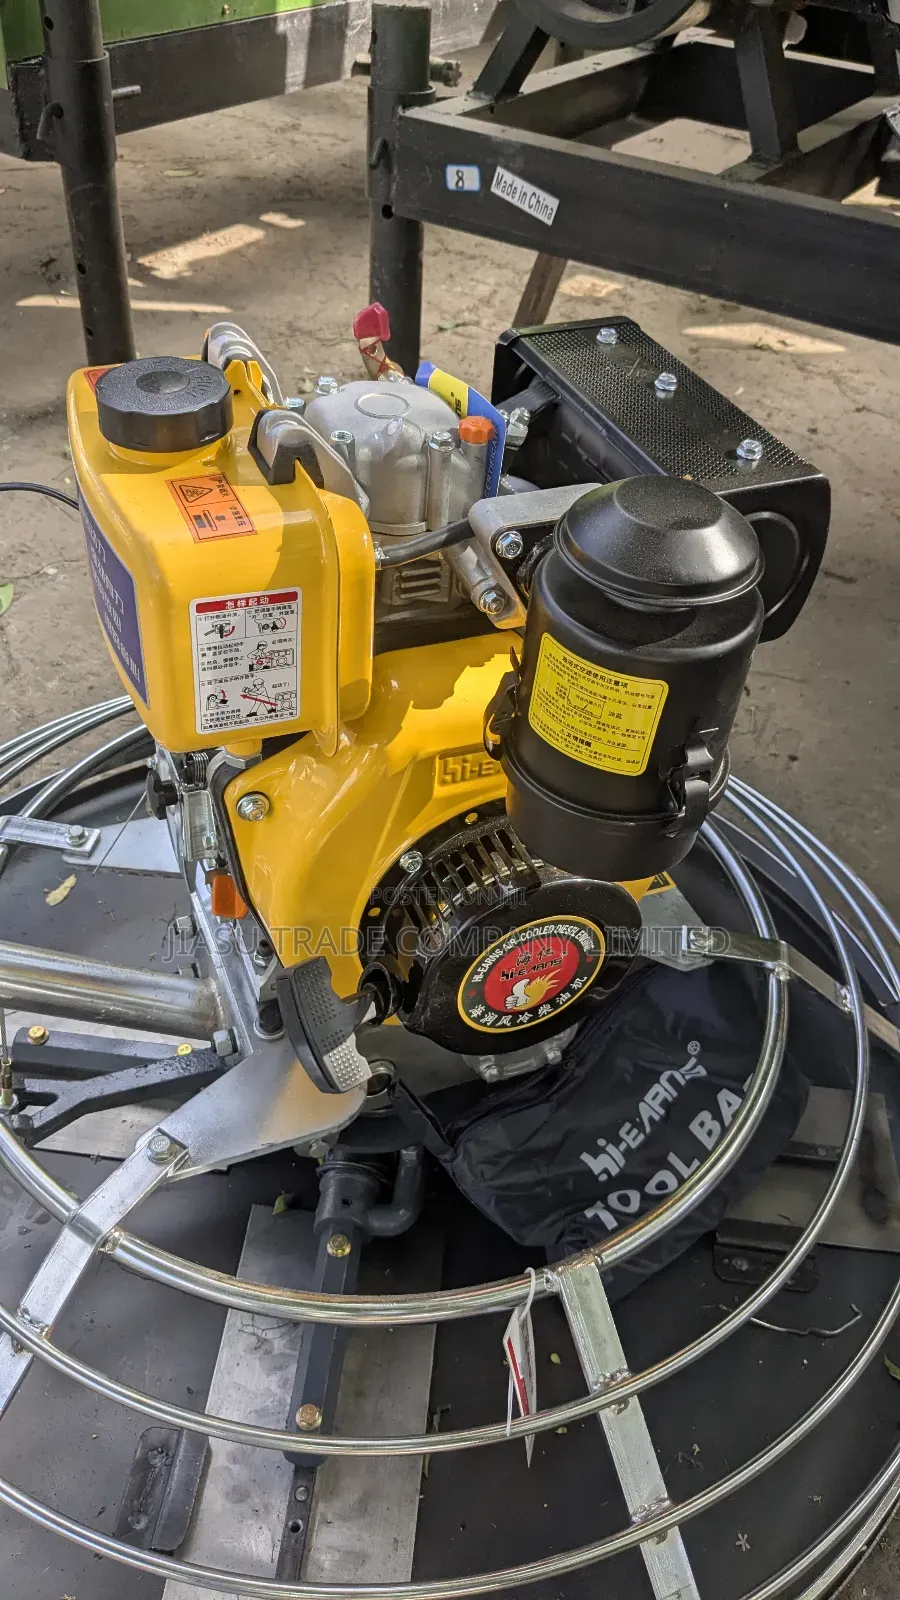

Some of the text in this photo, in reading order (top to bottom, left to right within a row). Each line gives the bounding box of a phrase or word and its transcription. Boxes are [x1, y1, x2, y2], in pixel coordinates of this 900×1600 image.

[454, 169, 465, 190] 8
[494, 173, 554, 220] Made in China
[225, 596, 269, 610] 怎样起动
[472, 948, 504, 983] HI-EARNS
[502, 925, 555, 953] AIR-COOLED
[583, 1073, 754, 1231] TOOL BA
